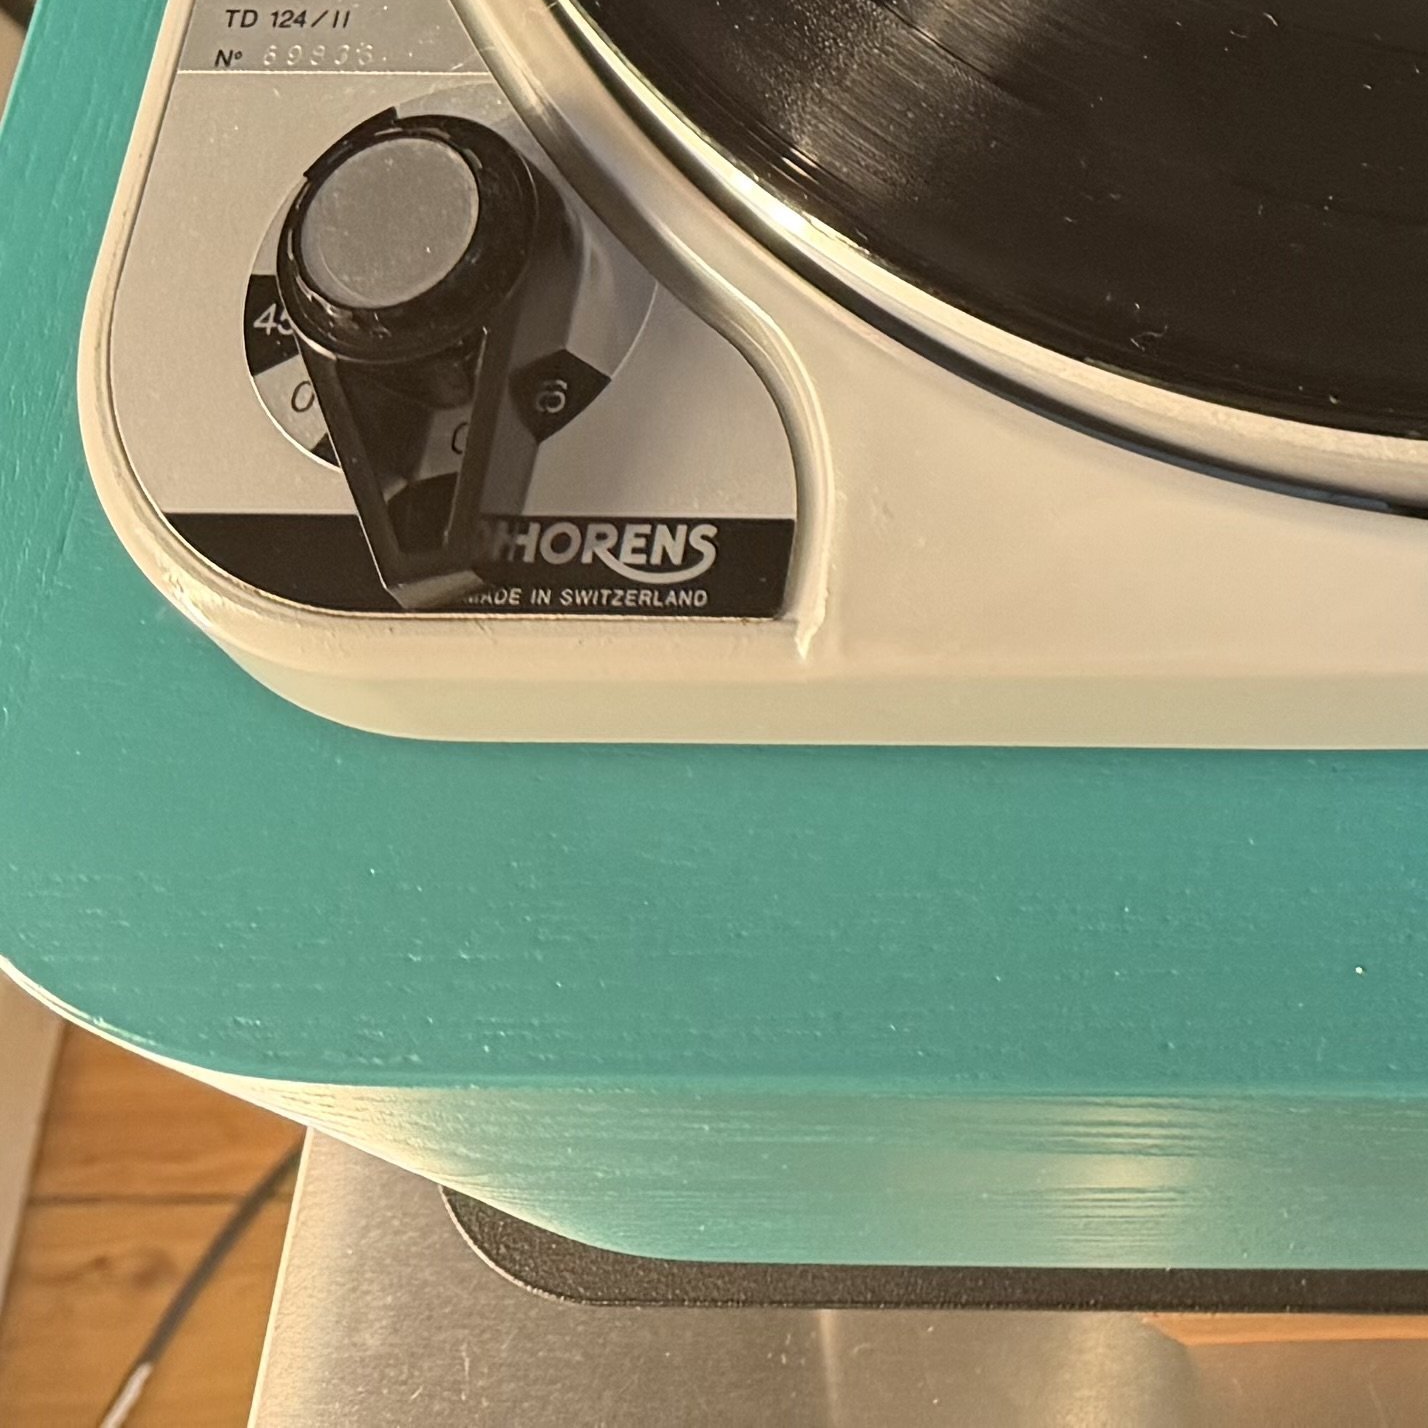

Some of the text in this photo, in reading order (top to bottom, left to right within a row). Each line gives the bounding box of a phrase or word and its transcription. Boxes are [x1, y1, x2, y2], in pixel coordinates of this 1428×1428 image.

[226, 9, 258, 29] TD
[530, 589, 552, 607] IN
[559, 589, 708, 609] SWITZERLAND
